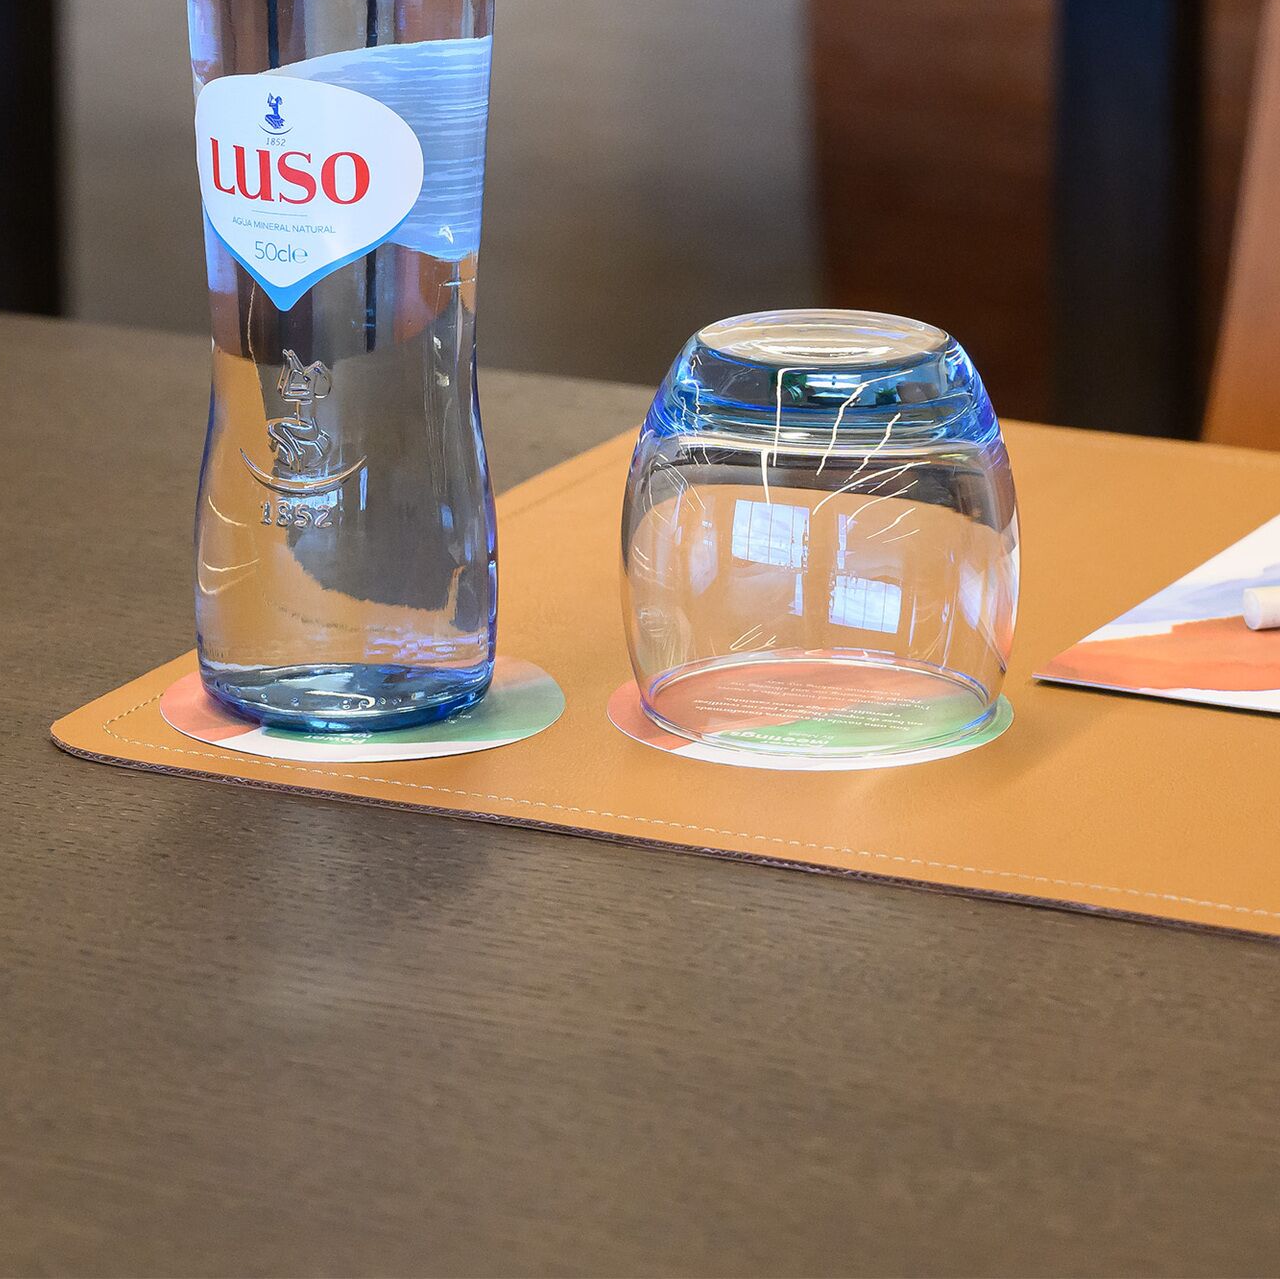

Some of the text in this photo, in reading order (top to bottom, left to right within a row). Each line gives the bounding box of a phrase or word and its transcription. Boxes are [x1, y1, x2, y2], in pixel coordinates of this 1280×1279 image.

[266, 137, 286, 147] 1852
[253, 220, 291, 232] MINERAL
[292, 224, 336, 234] NATURAL
